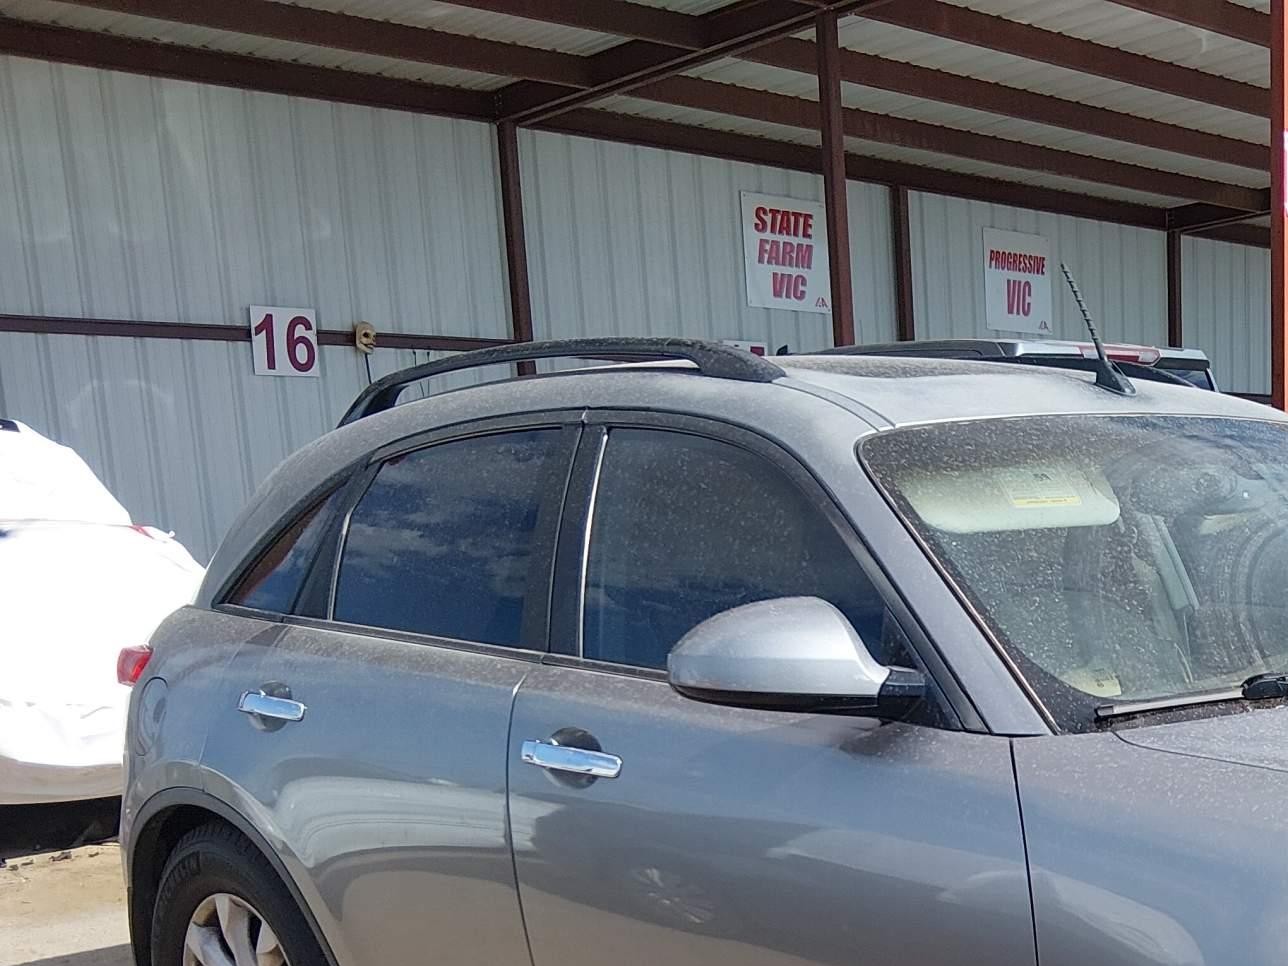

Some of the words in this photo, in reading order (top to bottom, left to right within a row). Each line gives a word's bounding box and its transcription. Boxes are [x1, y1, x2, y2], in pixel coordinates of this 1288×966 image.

[754, 206, 813, 240] STATE
[758, 238, 813, 270] FARM
[989, 249, 1046, 276] PROGRESSIVE
[772, 271, 807, 301] VIC
[1006, 278, 1032, 317] VIC
[254, 313, 316, 373] 16
